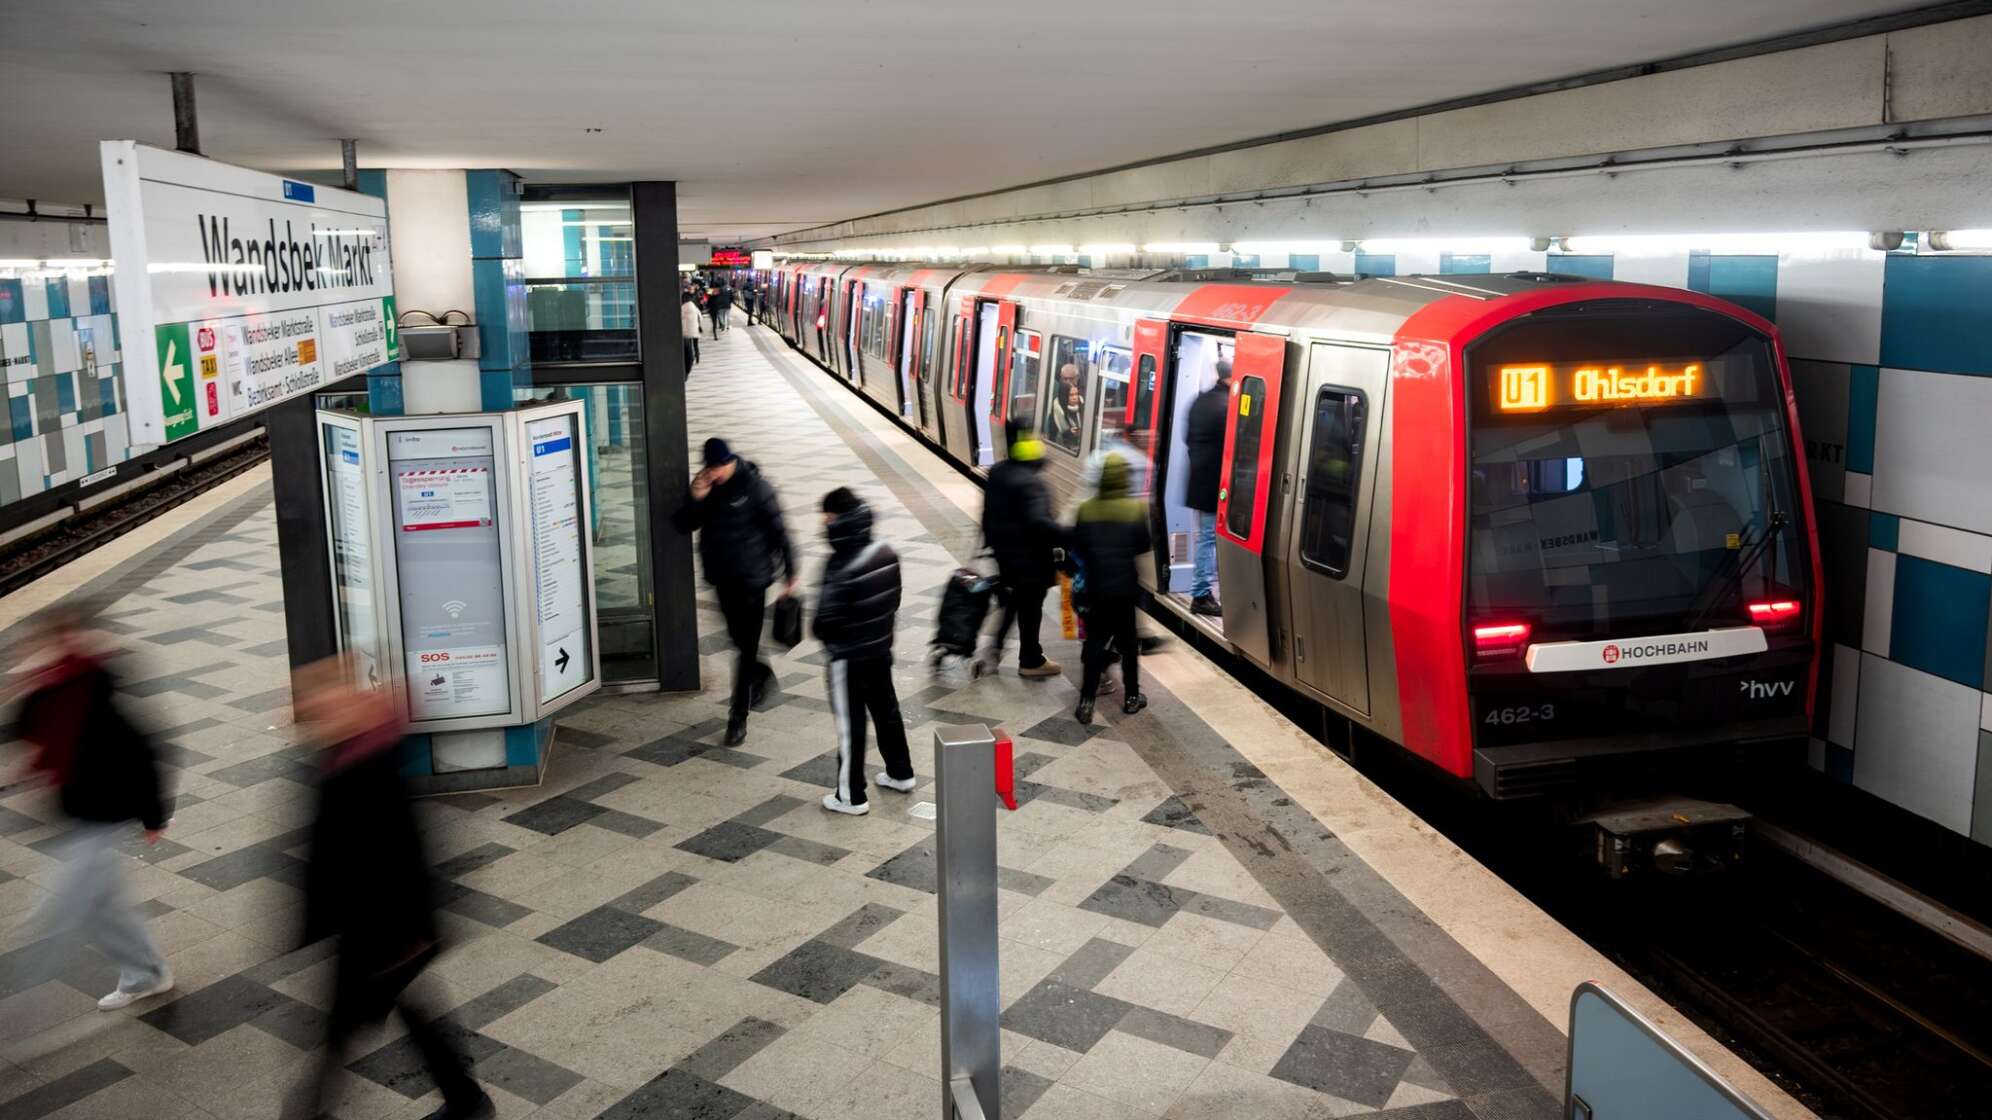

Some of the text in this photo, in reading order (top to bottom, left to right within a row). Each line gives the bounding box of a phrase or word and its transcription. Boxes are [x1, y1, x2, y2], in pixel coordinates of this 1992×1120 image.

[198, 214, 373, 297] Wandsbek Markt
[199, 332, 215, 348] BUS
[242, 316, 313, 345] Wandsbeker Marktstraße
[201, 357, 217, 376] TAXI
[245, 350, 283, 376] Wandsbeker
[1503, 366, 1699, 406] U1 Ohlsdorf
[536, 445, 545, 454] U1
[421, 652, 450, 663] SOS
[1622, 640, 1709, 659] HOCHBAHN
[1484, 704, 1555, 725] 462-3
